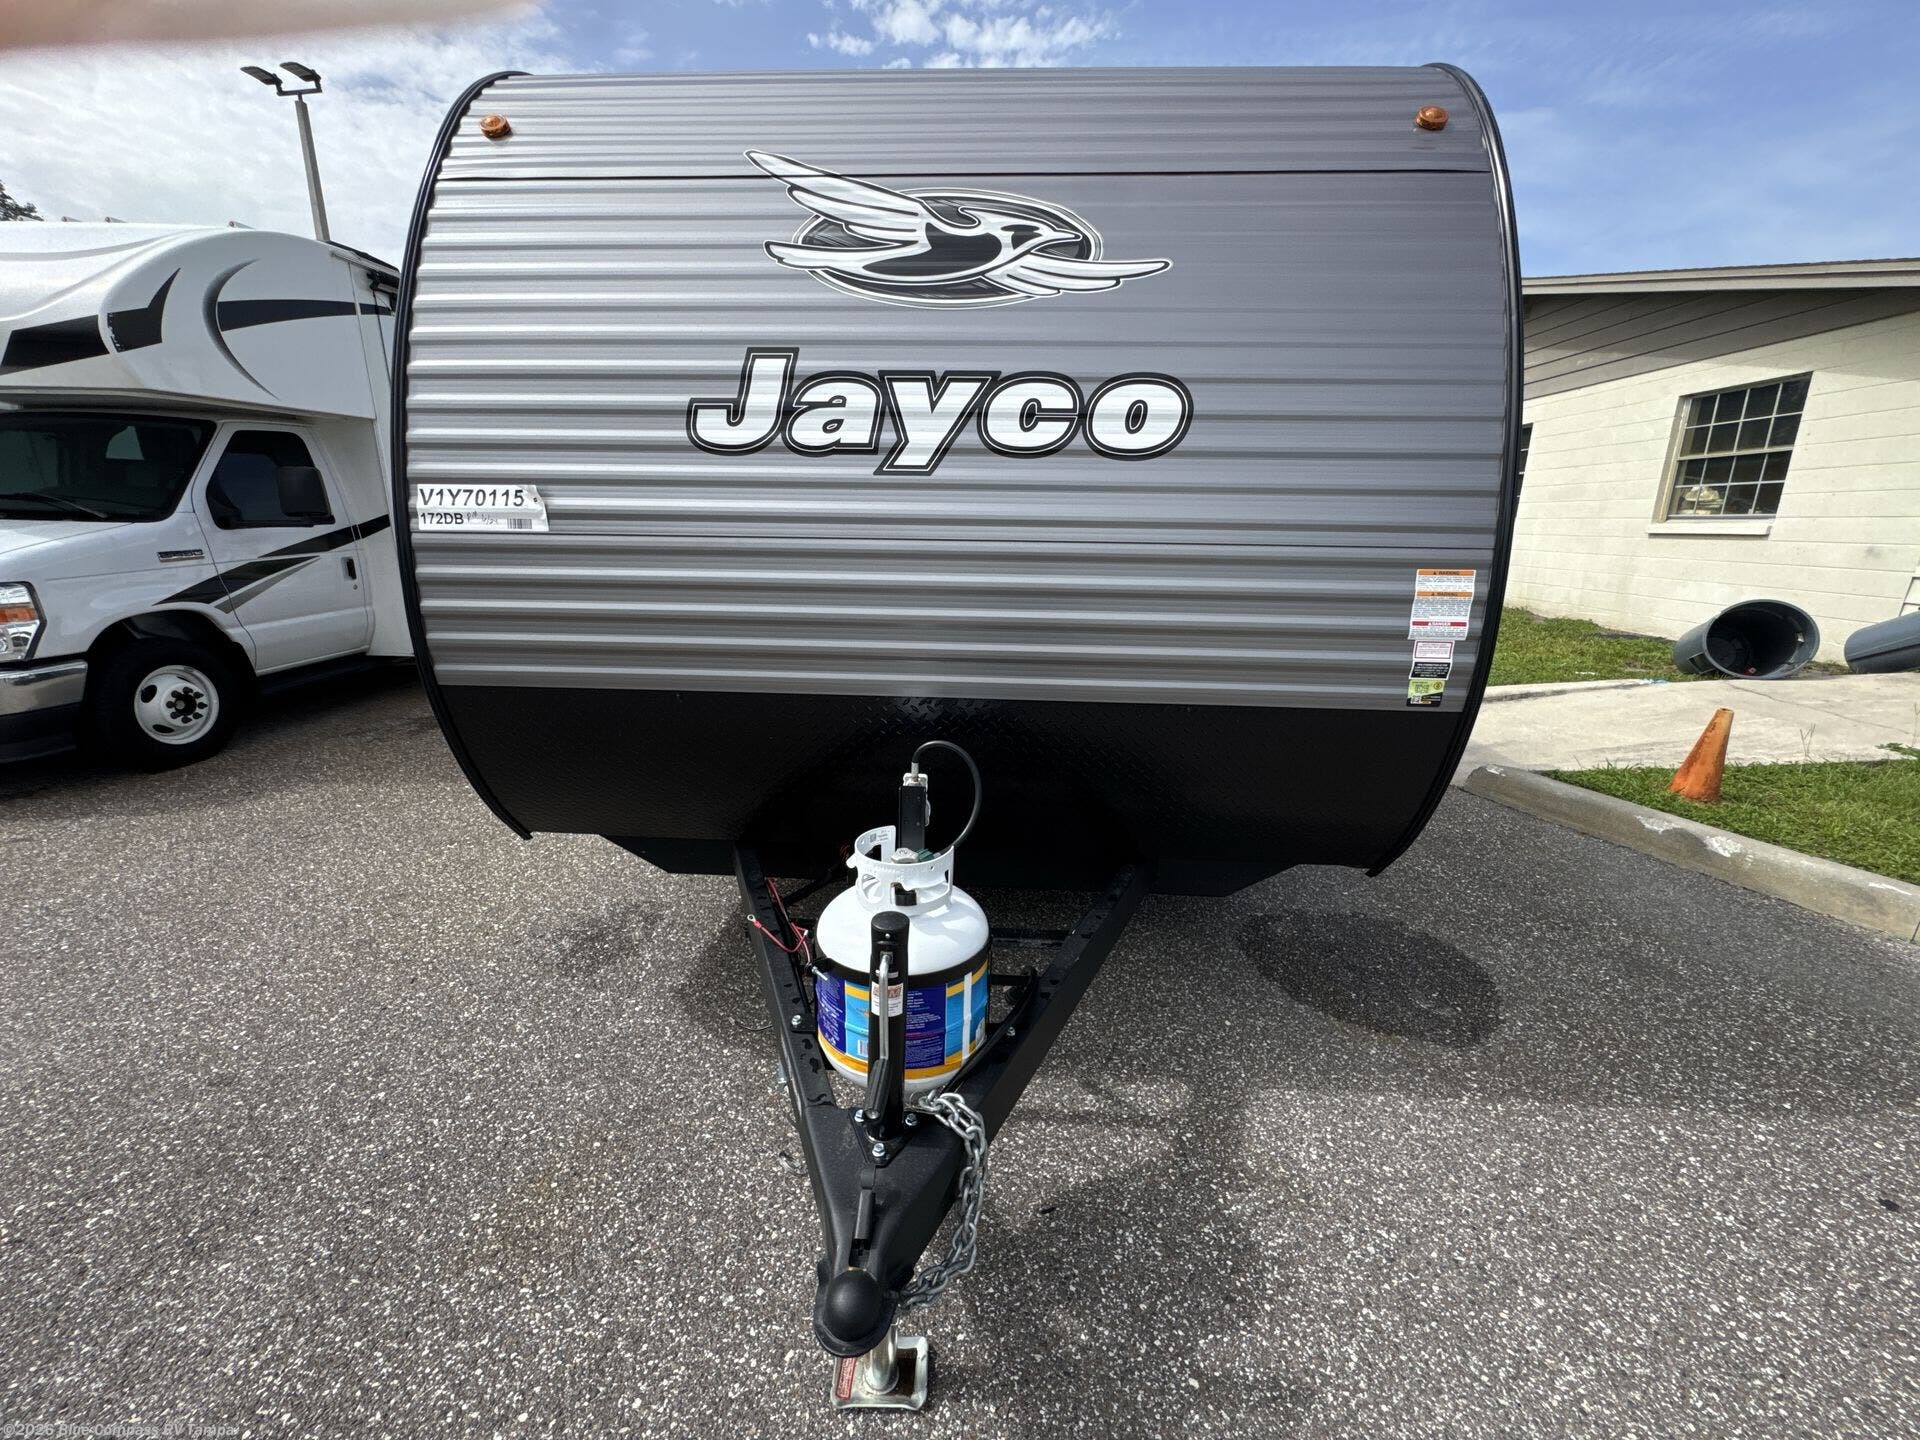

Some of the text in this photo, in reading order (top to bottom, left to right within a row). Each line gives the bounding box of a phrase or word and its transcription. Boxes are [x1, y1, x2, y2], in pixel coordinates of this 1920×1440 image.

[686, 347, 1195, 476] Jayco
[419, 488, 525, 507] V1Y70115
[420, 512, 464, 525] 172DB
